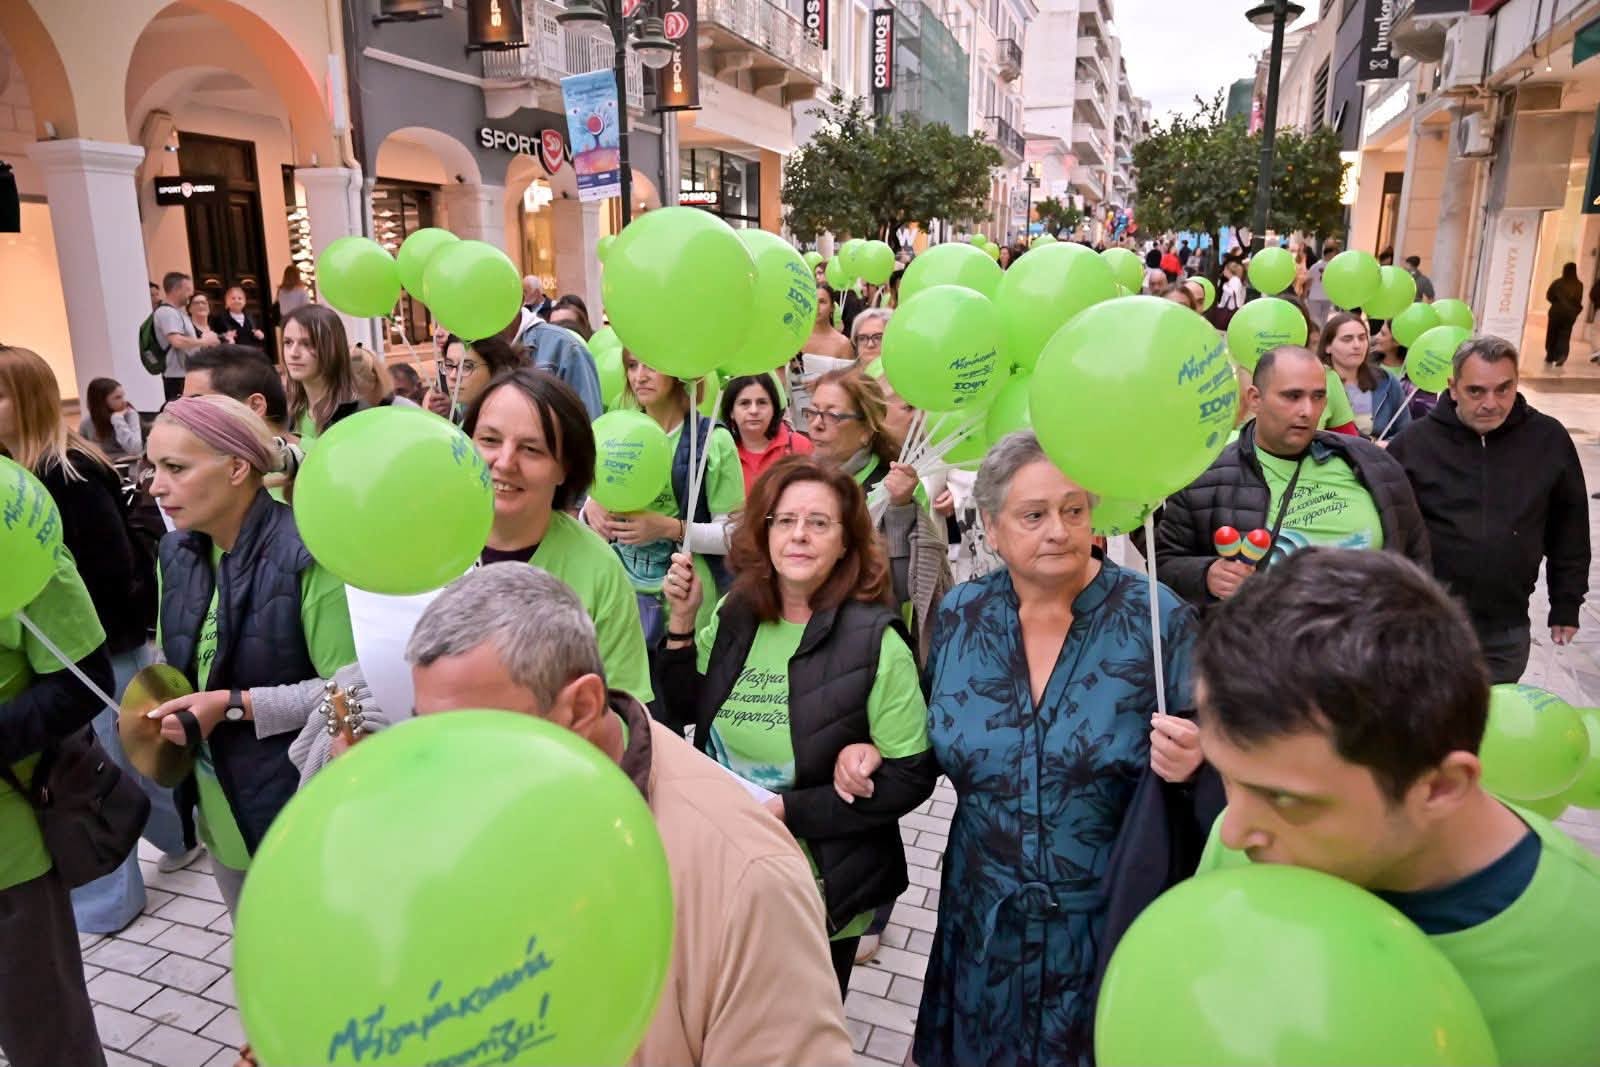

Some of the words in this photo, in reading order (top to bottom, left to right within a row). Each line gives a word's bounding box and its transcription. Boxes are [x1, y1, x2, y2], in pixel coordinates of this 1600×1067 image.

[875, 15, 886, 88] COSMOS
[480, 127, 541, 156] SPORT
[158, 186, 182, 194] SPORT
